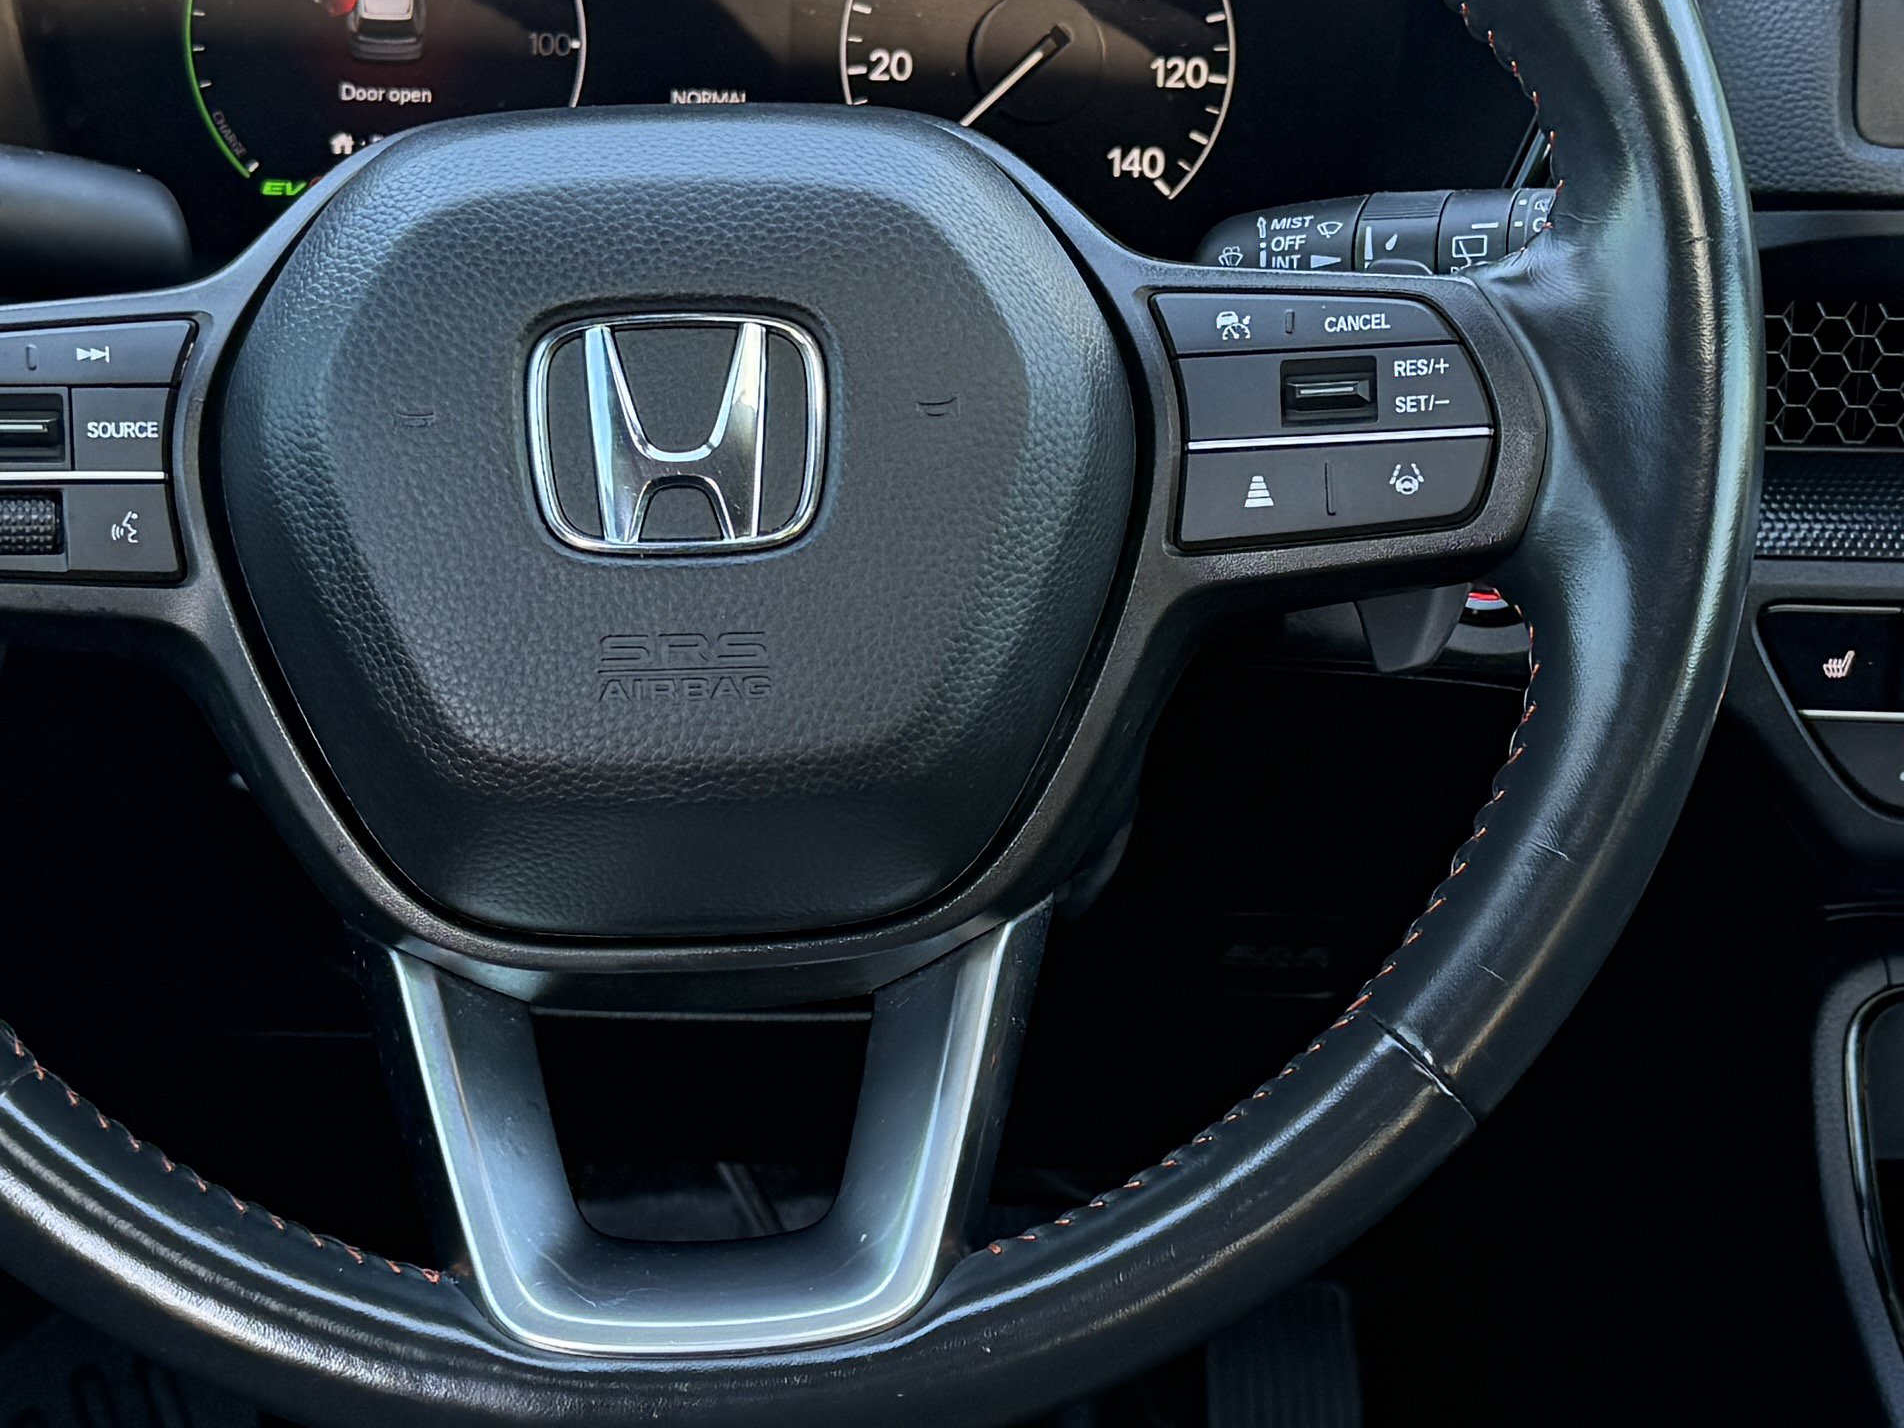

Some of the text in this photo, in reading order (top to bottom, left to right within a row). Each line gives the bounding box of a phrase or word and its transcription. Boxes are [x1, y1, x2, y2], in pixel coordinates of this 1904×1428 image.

[529, 33, 571, 57] 100
[868, 48, 913, 82] 20
[1150, 56, 1209, 90] 120
[339, 82, 433, 106] Door open
[211, 110, 248, 158] CHARGE
[1106, 146, 1166, 179] 140
[262, 179, 308, 196] EV
[1270, 215, 1314, 231] MIST
[1270, 234, 1307, 252] OFF
[1271, 255, 1302, 269] INT
[1323, 314, 1391, 333] CANCEL
[1393, 357, 1450, 378] RES/+
[86, 421, 159, 440] SOURCE
[598, 631, 769, 669] SRS
[598, 675, 772, 703] AIRBAG
